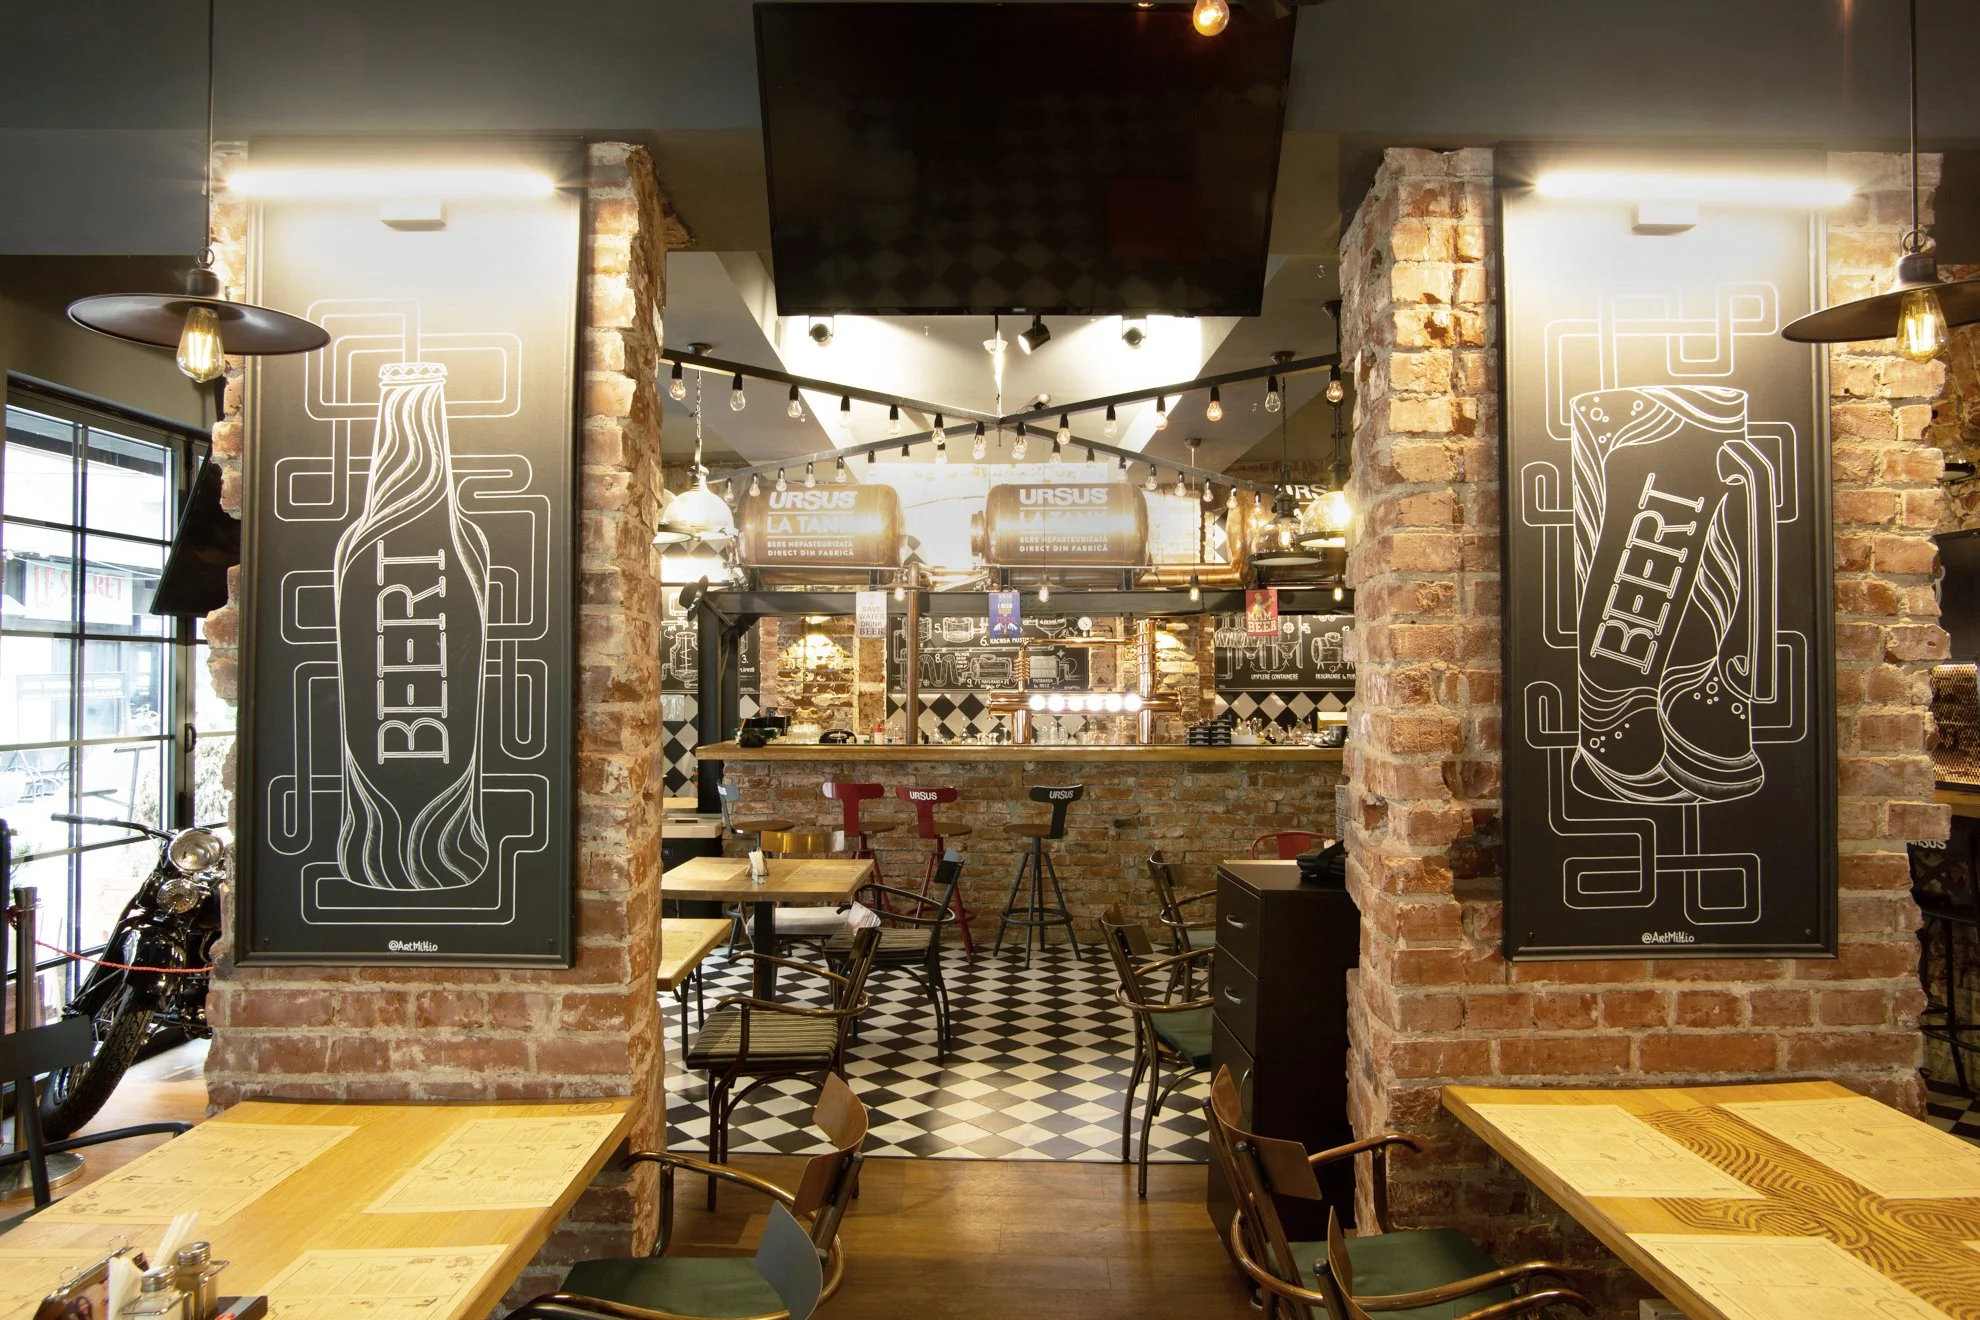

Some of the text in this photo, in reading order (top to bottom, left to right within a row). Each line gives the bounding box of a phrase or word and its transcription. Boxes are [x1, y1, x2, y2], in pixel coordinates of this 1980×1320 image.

[768, 490, 858, 511] URSUS
[1019, 487, 1109, 506] URSUS
[766, 515, 854, 533] LA TAN
[934, 624, 942, 634] 5.
[1247, 620, 1277, 633] BEER
[859, 628, 885, 636] BEER
[980, 636, 989, 646] 6.
[741, 654, 749, 664] 3.
[1271, 673, 1299, 681] CONTAINERE
[967, 678, 974, 688] 9.
[909, 791, 938, 801] URSUS
[1049, 790, 1074, 800] URSUS
